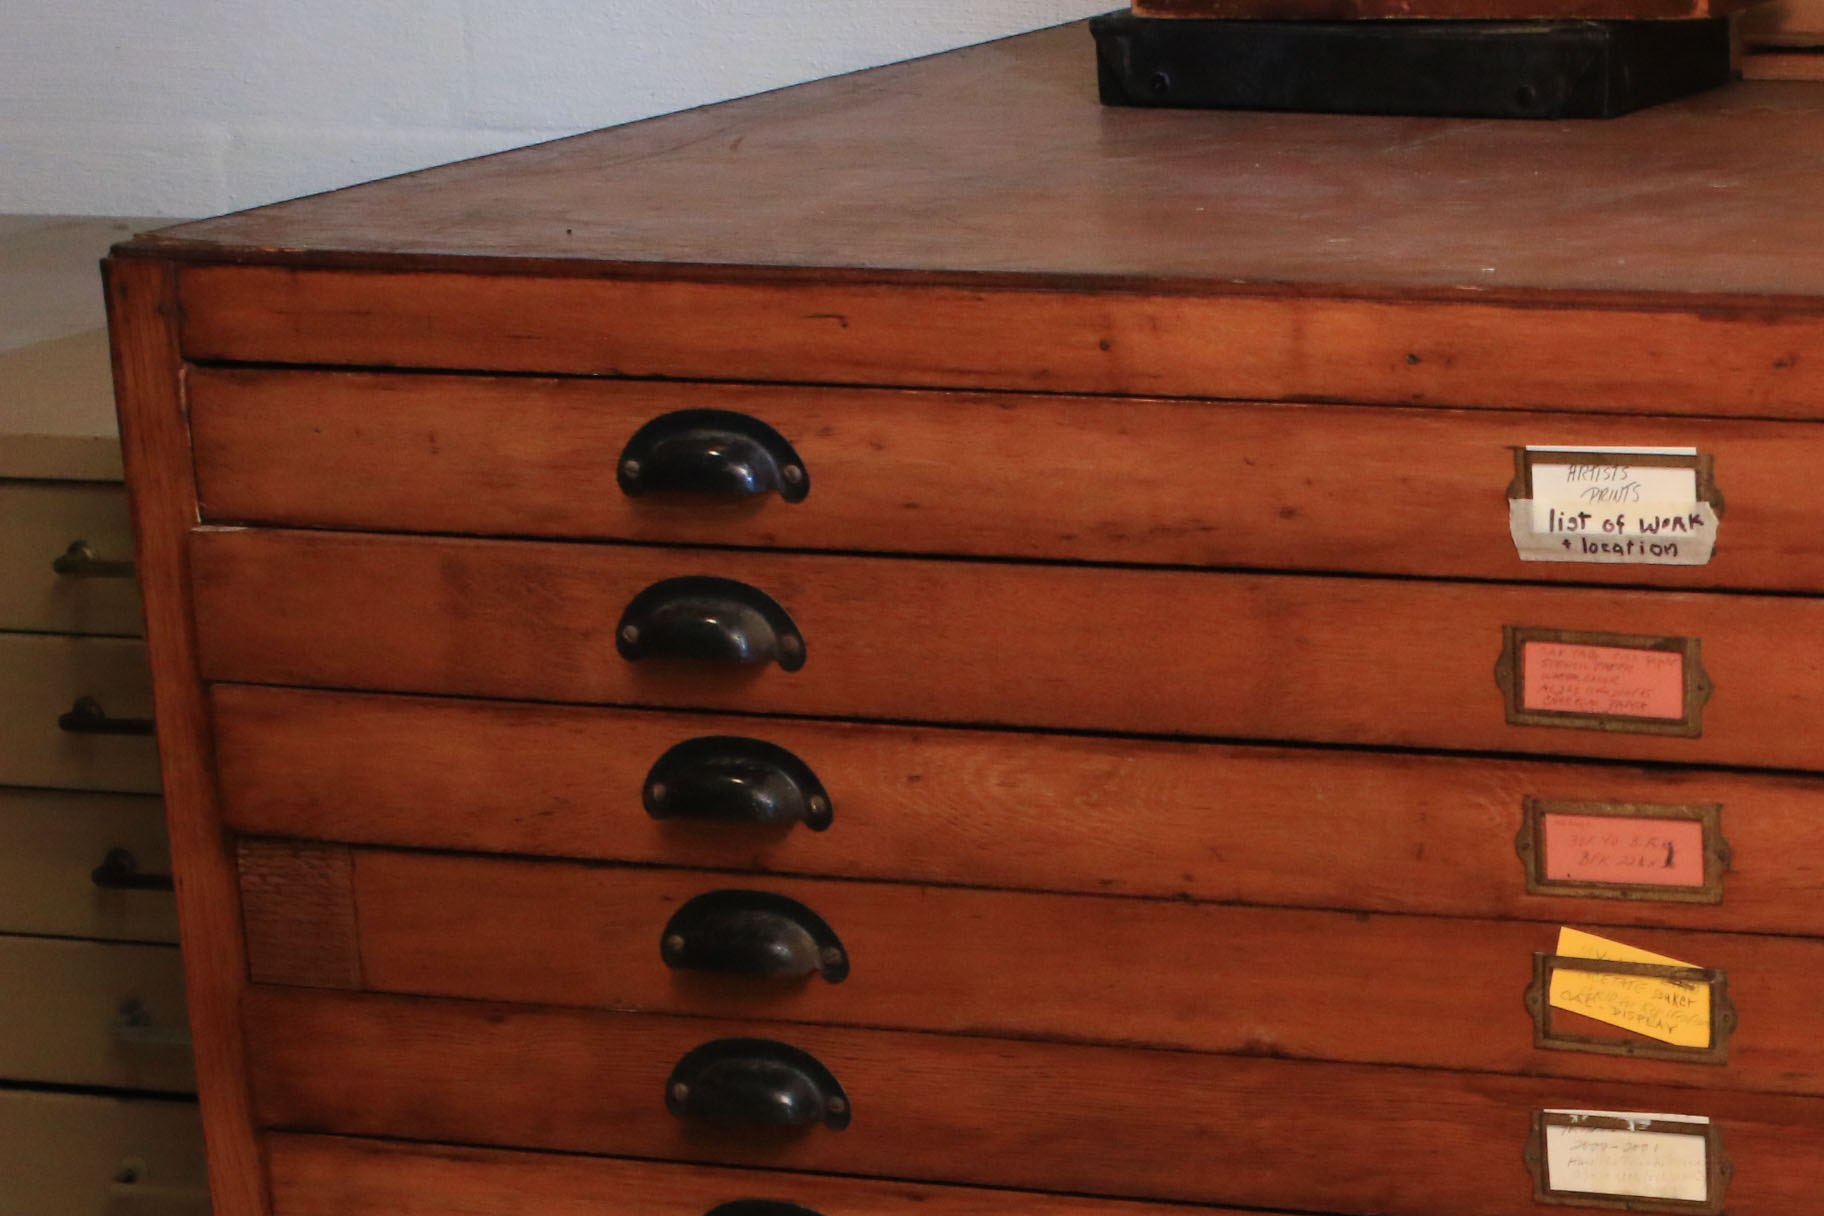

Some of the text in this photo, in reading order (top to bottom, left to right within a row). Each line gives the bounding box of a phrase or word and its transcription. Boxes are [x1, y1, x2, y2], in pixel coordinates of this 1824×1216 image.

[1549, 508, 1592, 532] list
[1602, 514, 1625, 534] of
[1582, 537, 1678, 557] location
